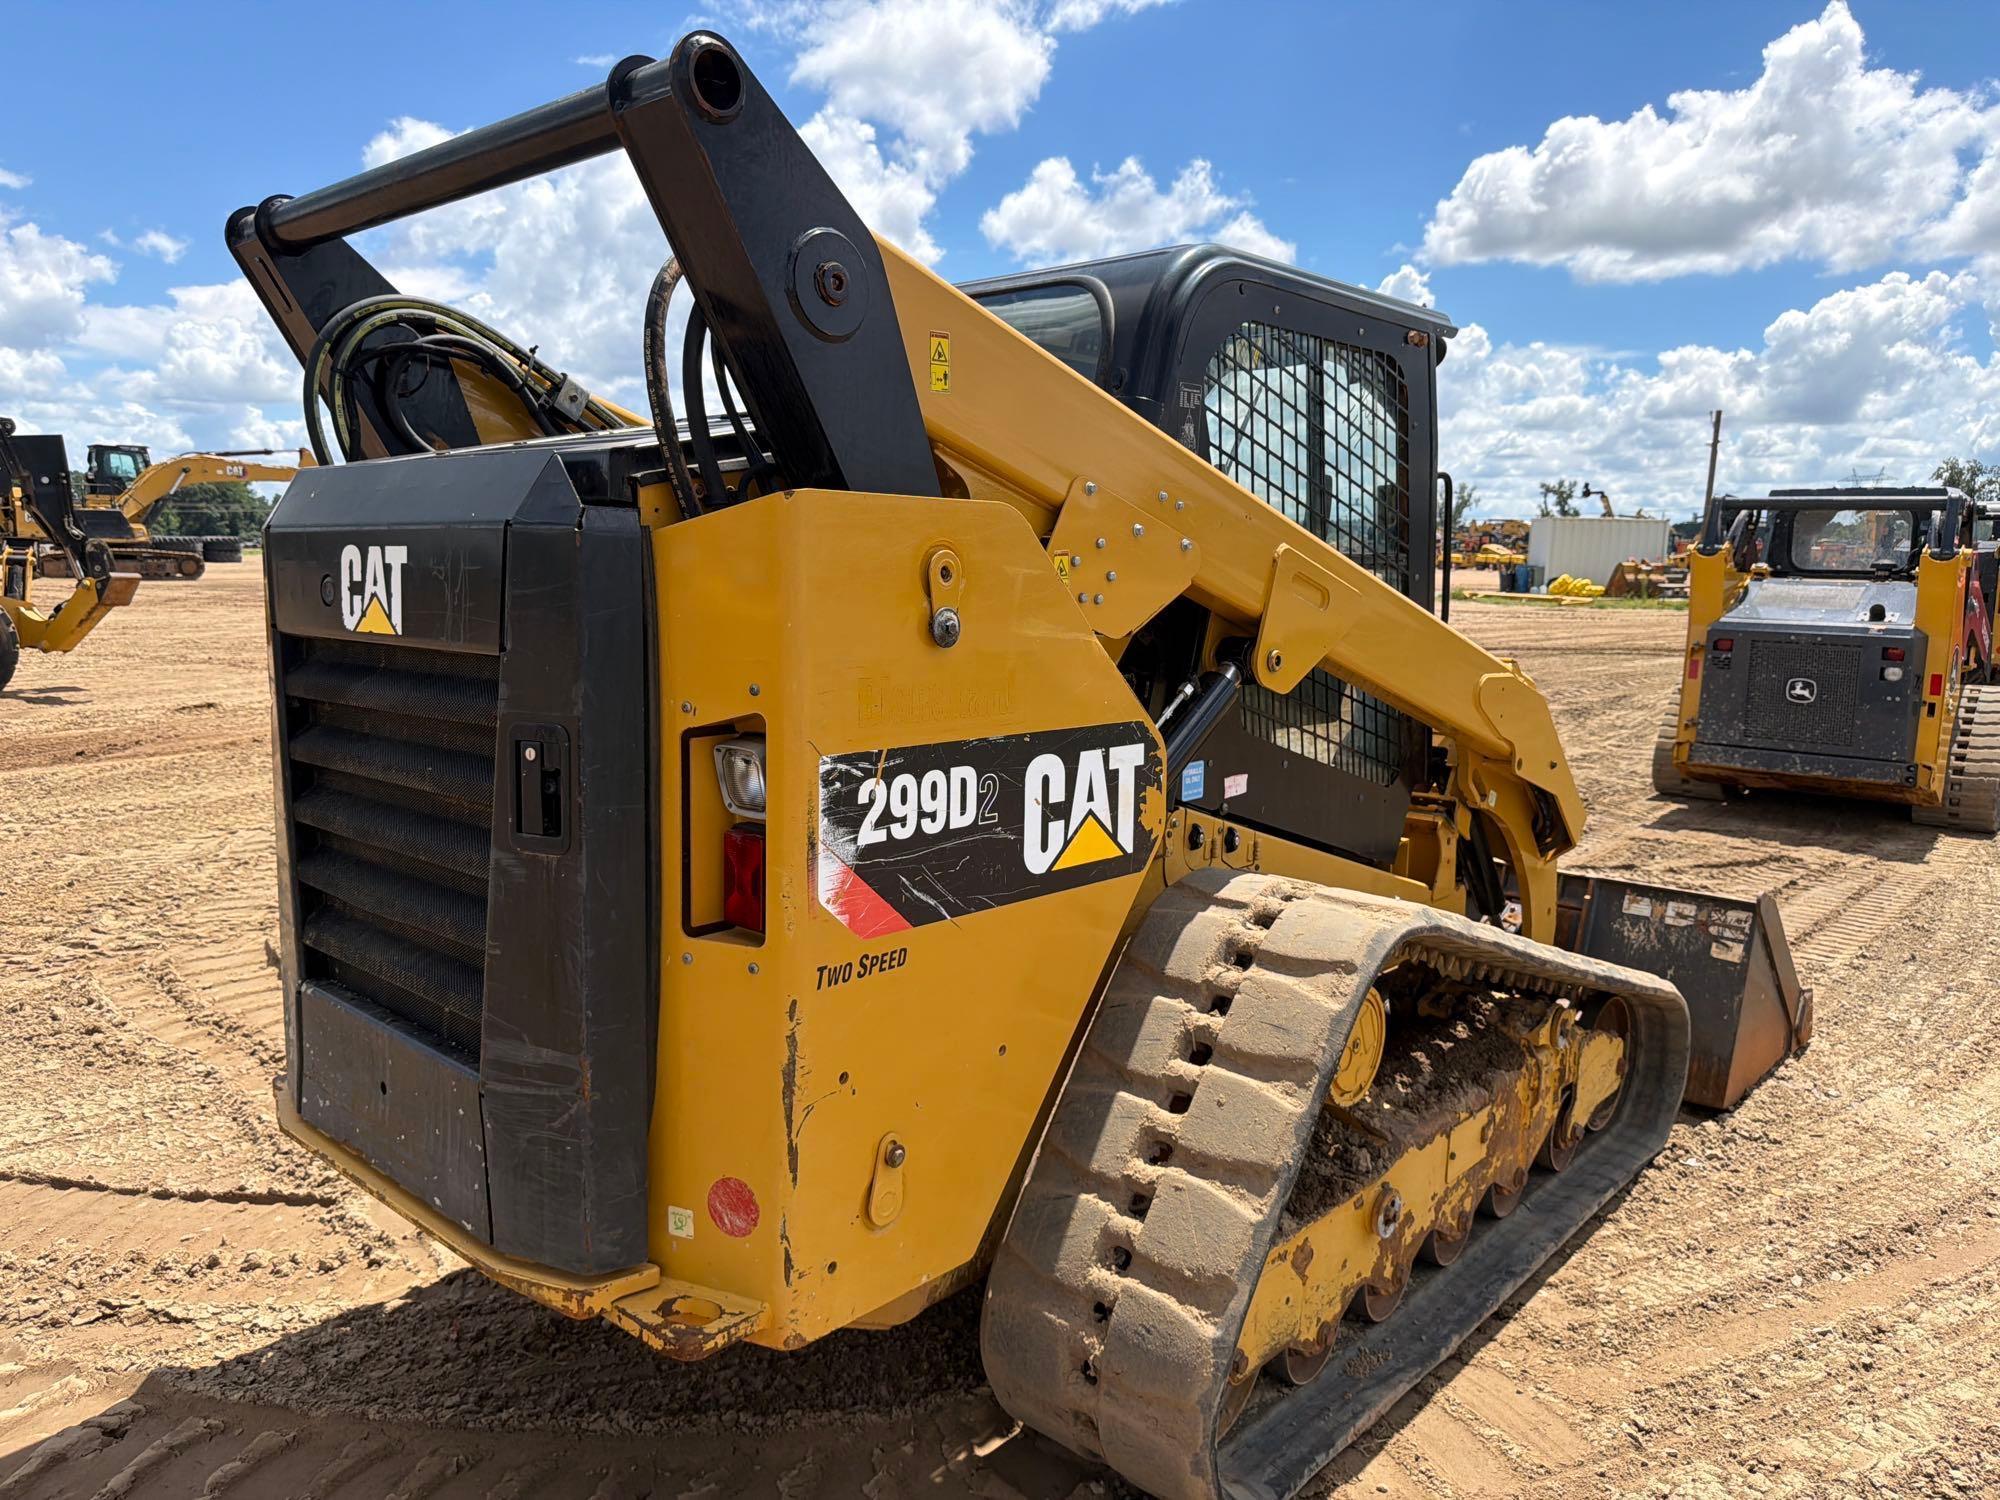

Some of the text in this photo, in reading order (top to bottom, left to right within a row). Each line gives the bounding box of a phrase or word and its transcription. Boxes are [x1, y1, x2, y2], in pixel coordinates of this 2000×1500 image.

[226, 465, 243, 476] CAT
[341, 544, 408, 635] CAT
[1024, 743, 1144, 874] CAT
